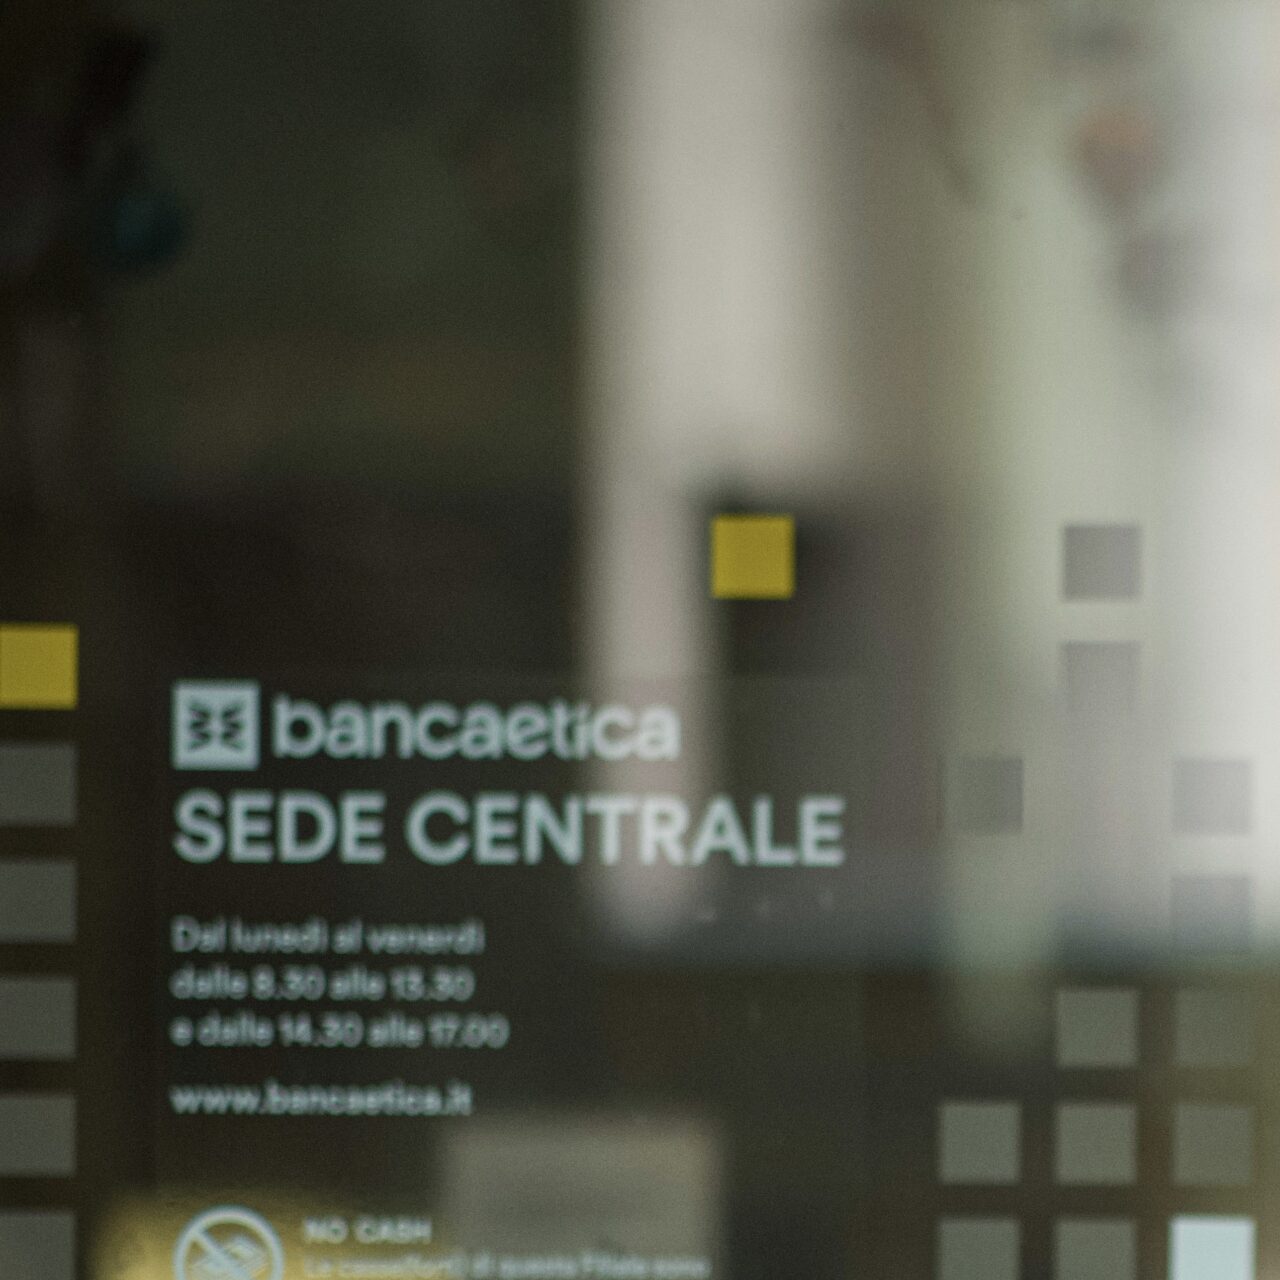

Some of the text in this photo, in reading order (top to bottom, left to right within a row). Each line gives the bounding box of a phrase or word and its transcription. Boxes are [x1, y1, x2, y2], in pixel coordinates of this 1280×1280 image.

[271, 694, 682, 762] bancaetica
[172, 791, 847, 867] SEDE CENTRALE
[170, 915, 227, 954] Dal
[170, 963, 249, 1001] dalle
[328, 964, 387, 1001] alle
[196, 1009, 275, 1047] dalle
[366, 1010, 425, 1048] alle
[169, 1077, 473, 1117] www.bancaetica.it
[303, 1217, 432, 1245] NO CASH
